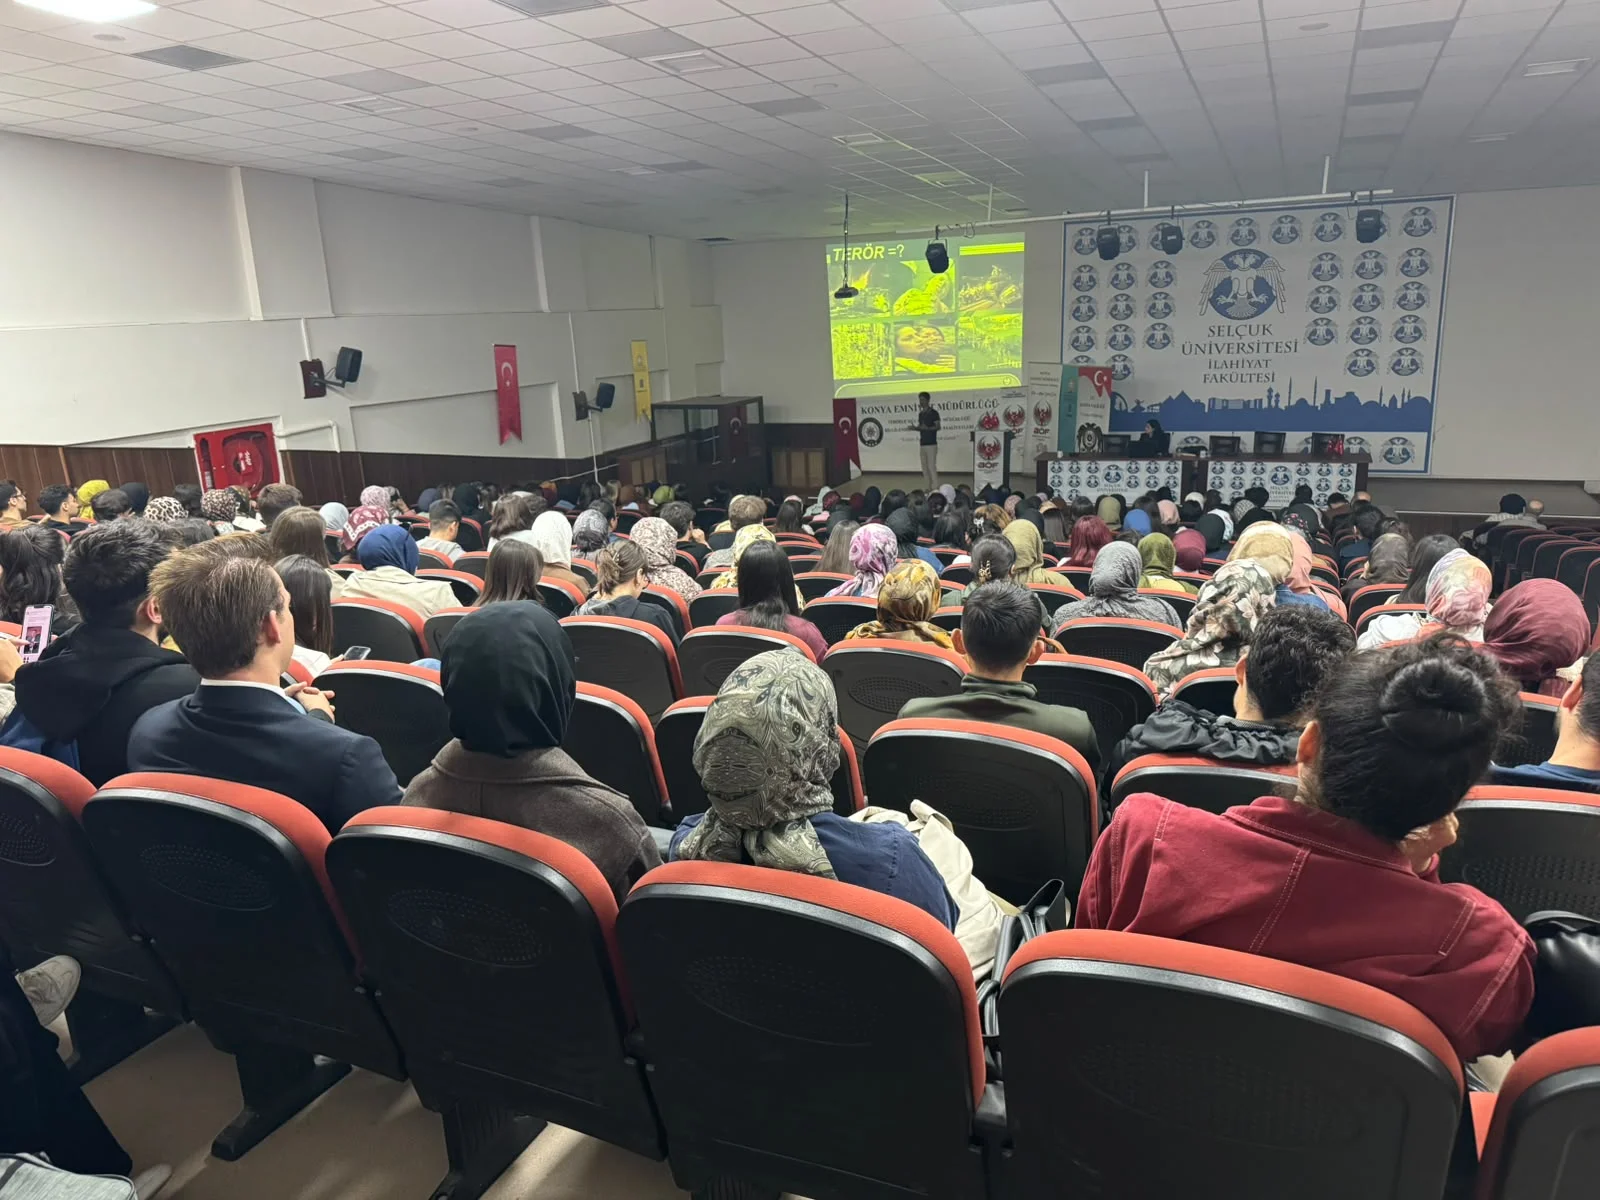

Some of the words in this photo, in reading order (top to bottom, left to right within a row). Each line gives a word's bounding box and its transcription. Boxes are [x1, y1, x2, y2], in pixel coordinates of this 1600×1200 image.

[832, 243, 885, 261] TERÖR
[1207, 324, 1273, 340] SELÇUK
[1182, 339, 1298, 355] ÜNİVERSİTESİ
[1208, 358, 1272, 369] İLAHİYAT
[1203, 371, 1275, 383] FAKÜLTESİ
[861, 405, 892, 415] KONYA
[937, 398, 999, 411] MÜDÜRLÜĞÜ
